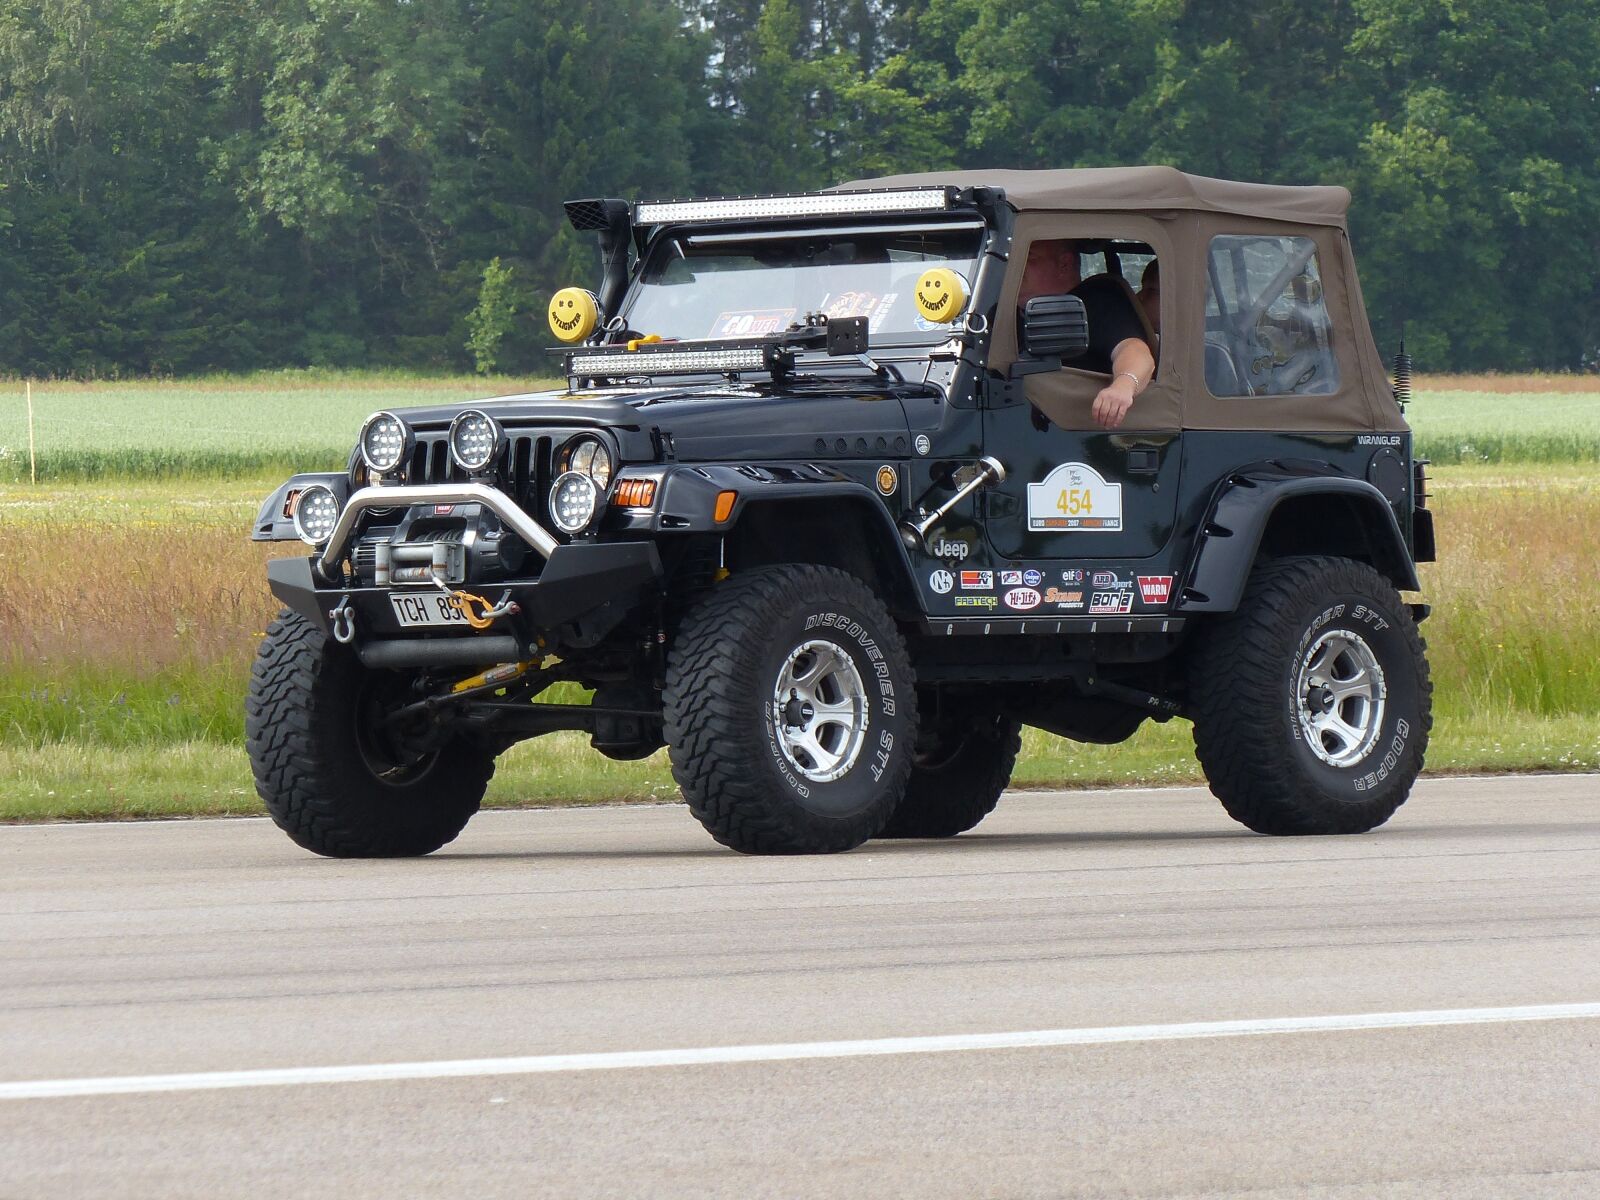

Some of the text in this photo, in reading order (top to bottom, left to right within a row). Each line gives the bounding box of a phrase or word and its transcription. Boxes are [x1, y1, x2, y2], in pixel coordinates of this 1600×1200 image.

[1358, 435, 1401, 445] WRANGLER
[1056, 488, 1092, 515] 454
[934, 540, 969, 560] Jeep
[1062, 571, 1076, 581] elf
[1110, 580, 1134, 590] sport
[1142, 584, 1167, 596] WARN
[393, 597, 430, 622] TCH
[1352, 604, 1390, 632] STT
[805, 612, 896, 783] DISCOVERER STT
[1353, 718, 1410, 792] COOPER
